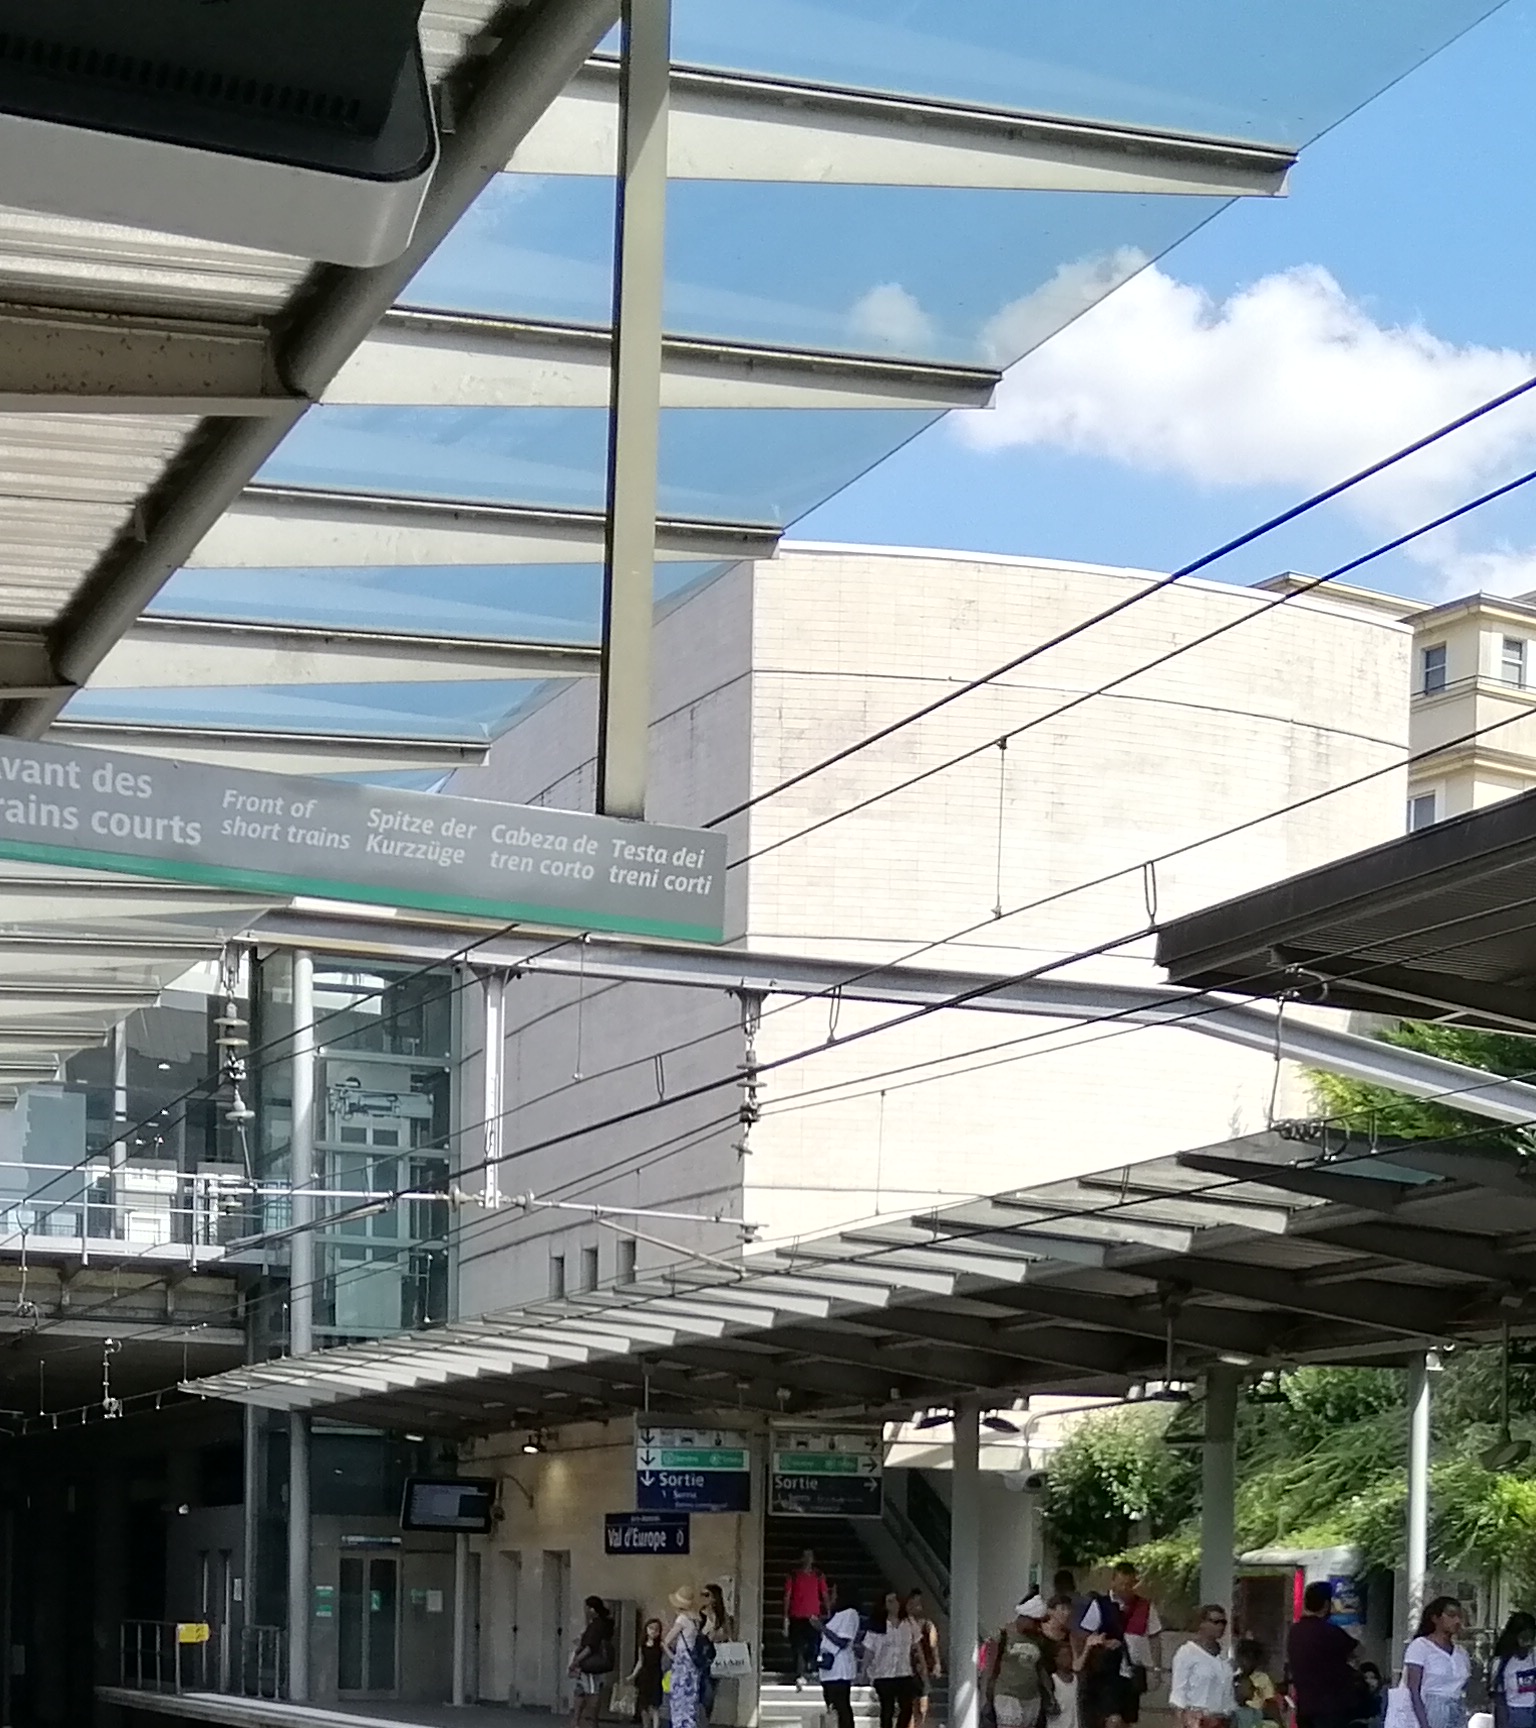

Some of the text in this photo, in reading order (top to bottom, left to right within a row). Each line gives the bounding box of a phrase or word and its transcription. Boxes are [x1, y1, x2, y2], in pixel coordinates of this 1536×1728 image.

[92, 762, 152, 798] des
[221, 789, 318, 819] Front of
[91, 810, 202, 846] courts
[221, 816, 352, 850] short trains
[367, 807, 478, 840] Spitze der
[366, 833, 466, 868] Kurzzüge
[491, 824, 599, 855] Cabeza de
[612, 839, 705, 869] Testa dei
[490, 851, 595, 881] tren corto
[609, 865, 713, 895] treni corti
[659, 1472, 706, 1488] Sortie
[775, 1475, 818, 1490] Sortie
[607, 1526, 667, 1552] Val d'Europe
